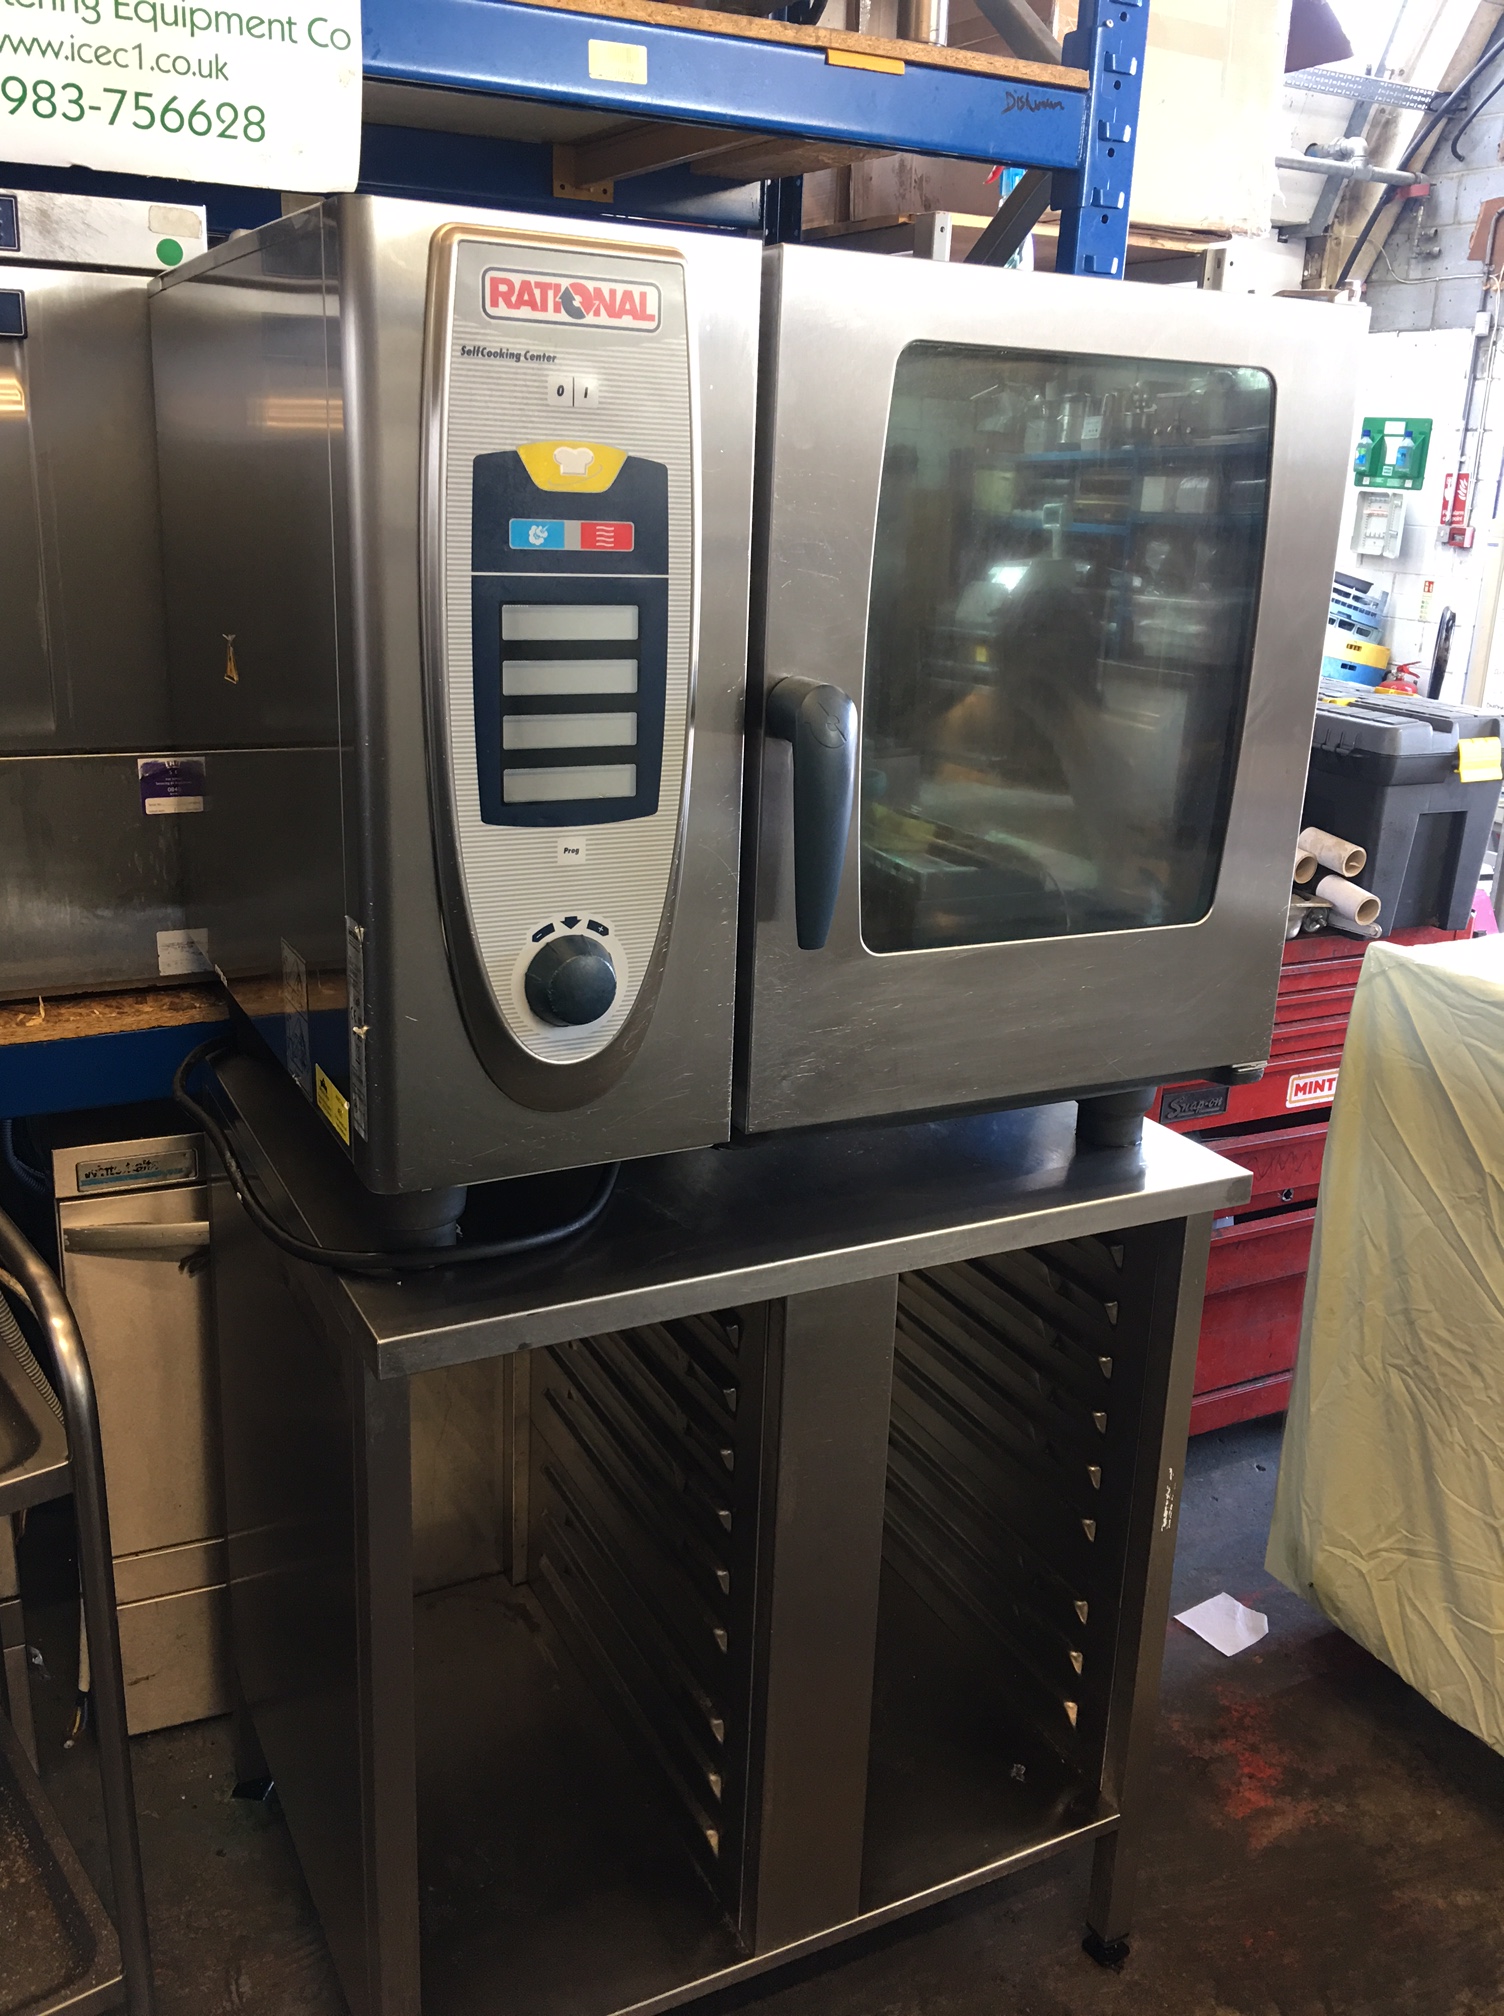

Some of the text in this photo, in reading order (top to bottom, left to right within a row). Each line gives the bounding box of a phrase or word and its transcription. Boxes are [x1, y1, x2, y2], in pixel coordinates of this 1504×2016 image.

[114, 0, 298, 43] Equipment
[307, 17, 351, 50] Co
[0, 34, 229, 81] ww.icec1.co.uk
[1, 75, 266, 142] 983-756628
[489, 276, 656, 322] RATIONAL
[460, 345, 557, 363] SelfCooking Center
[563, 847, 580, 855] Prog
[1294, 1077, 1337, 1097] MINT
[1167, 1096, 1223, 1119] Snap-on
